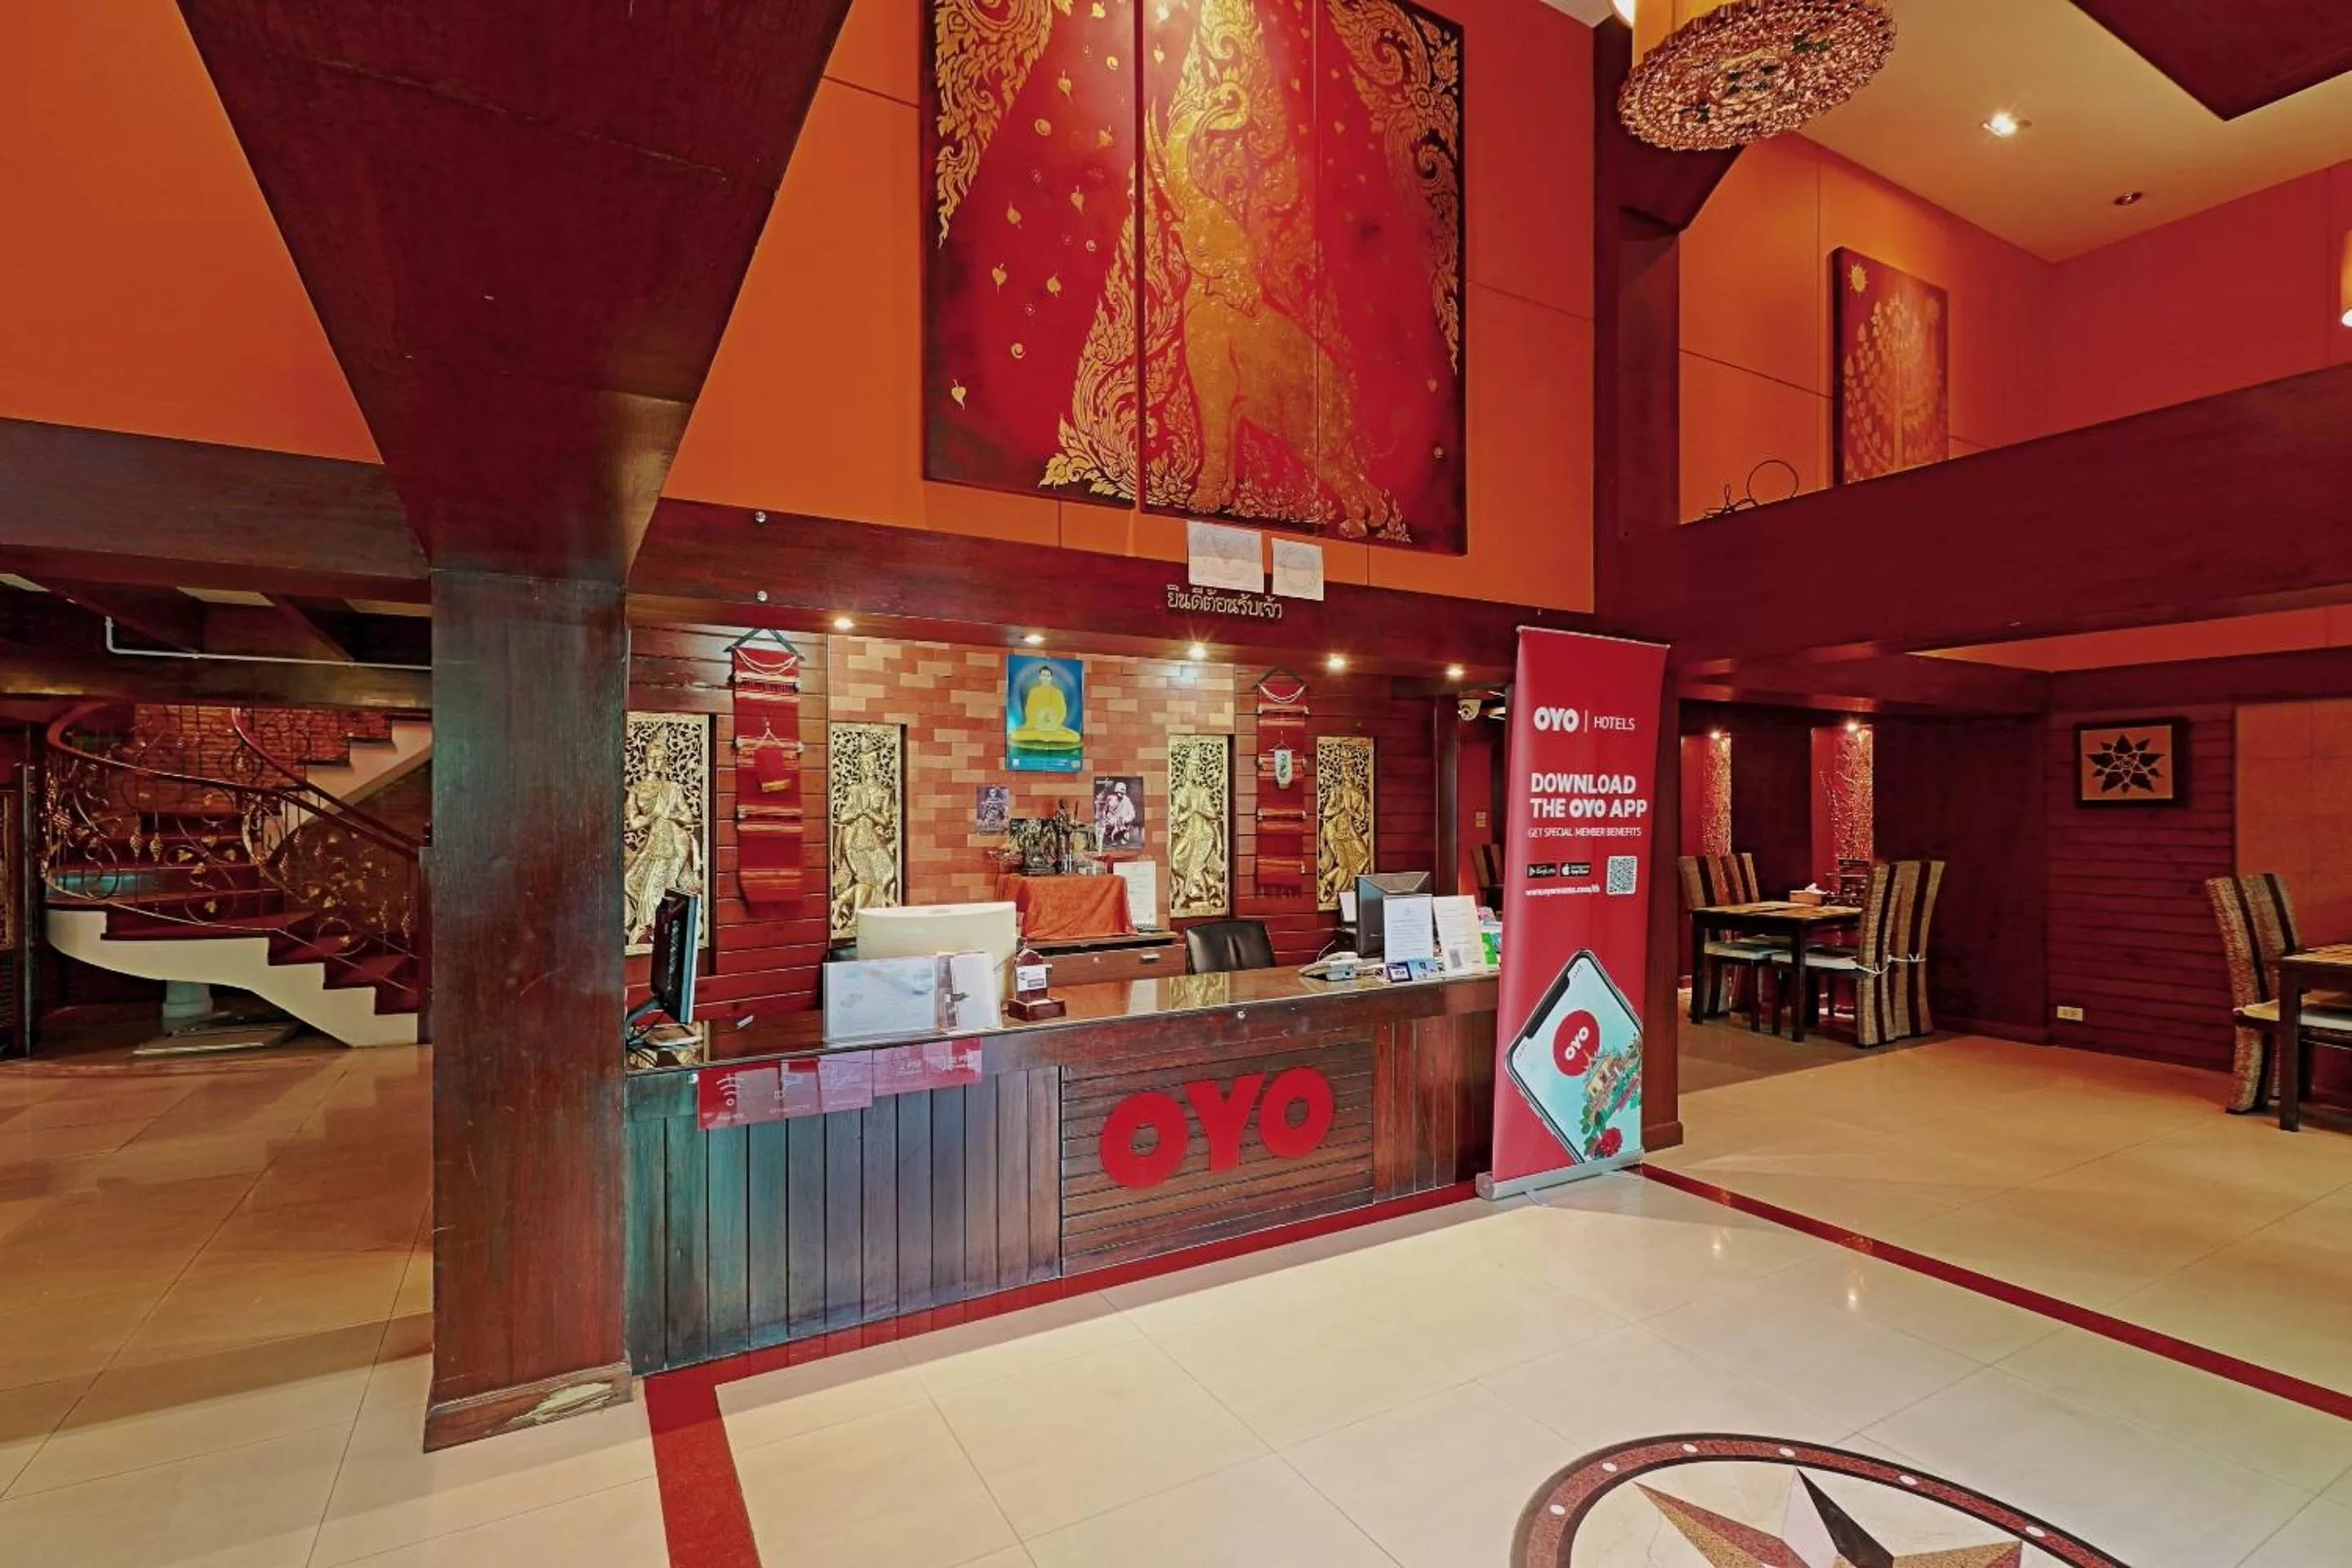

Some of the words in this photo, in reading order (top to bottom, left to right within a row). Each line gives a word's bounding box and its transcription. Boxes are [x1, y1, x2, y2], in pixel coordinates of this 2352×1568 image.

[1533, 706, 1579, 733] OYO
[1593, 715, 1635, 731] HOTELS
[1530, 773, 1637, 795] DOWNLOAD
[1530, 798, 1566, 818] THE
[1569, 799, 1606, 817] OYO
[1610, 799, 1648, 817] APP
[1528, 827, 1544, 838] GET
[1544, 826, 1573, 837] SPECIAL
[1575, 827, 1606, 837] MEMBER
[1606, 827, 1642, 837] BENEFITS
[1565, 1026, 1589, 1061] OYO
[1098, 1066, 1334, 1190] OYO
